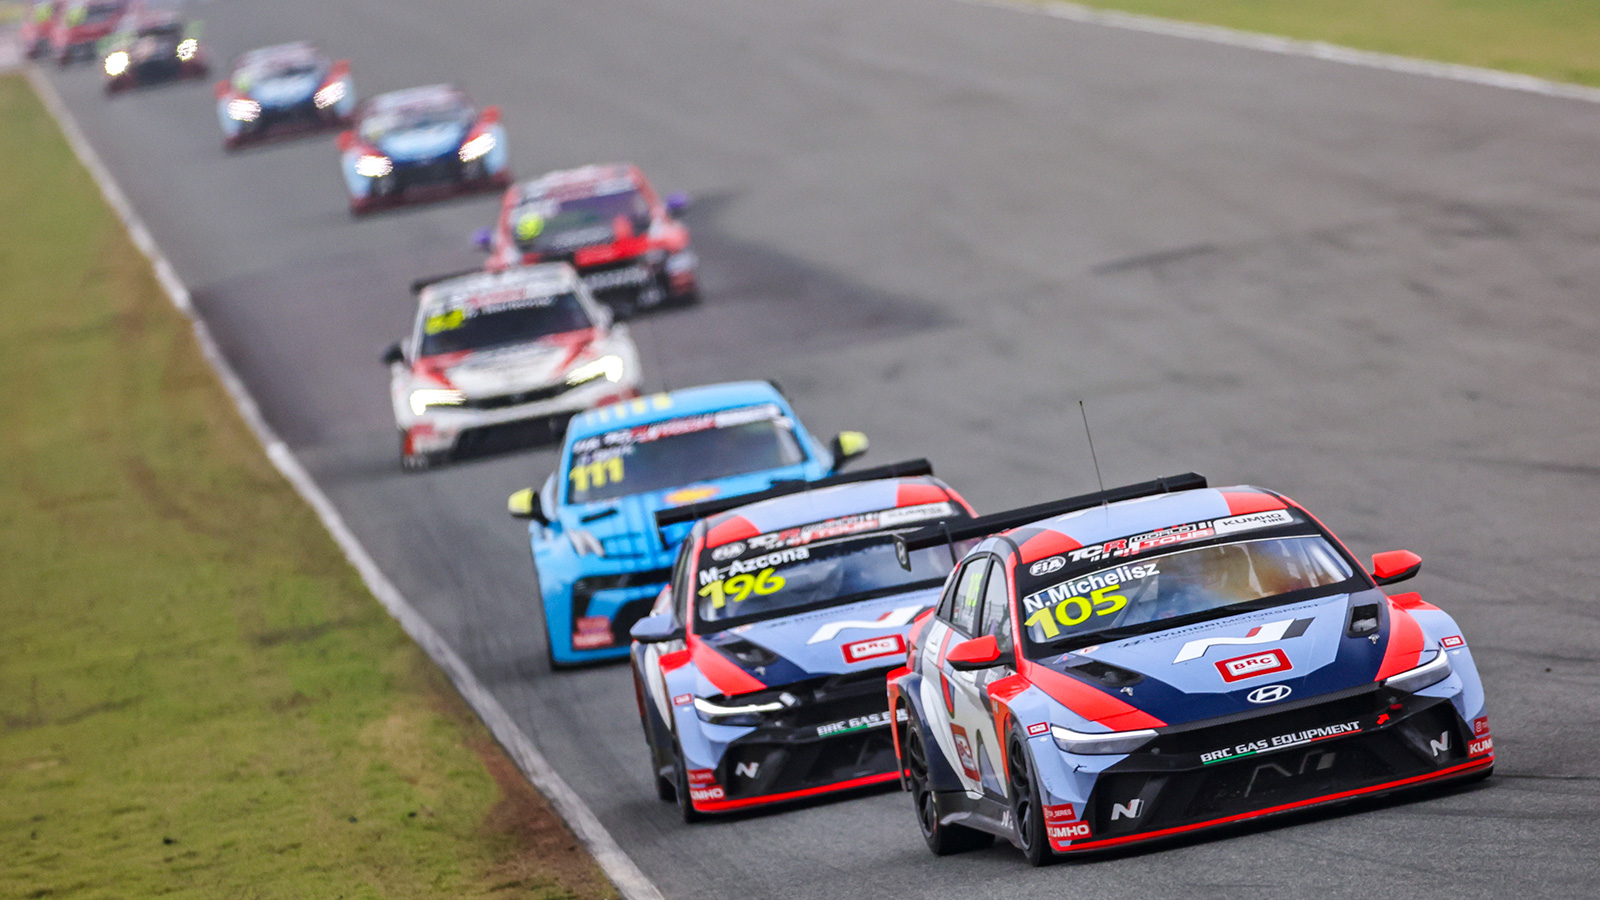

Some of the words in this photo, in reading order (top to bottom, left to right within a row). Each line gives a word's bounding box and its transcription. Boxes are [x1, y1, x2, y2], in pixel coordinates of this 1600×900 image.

[569, 457, 624, 491] 111
[1223, 512, 1282, 526] KUMHO
[1261, 516, 1285, 525] TIRE
[1145, 530, 1210, 547] TOUR
[1068, 539, 1127, 562] TCR
[699, 566, 725, 585] M.
[729, 547, 811, 577] Azcona
[1033, 557, 1064, 573] FIA
[698, 568, 786, 610] 196
[1022, 562, 1160, 613] N.Michelisz
[1024, 584, 1128, 639] 105
[1148, 620, 1220, 641] HYUNDAI
[1227, 603, 1321, 624] MOTORSPORT
[856, 641, 892, 653] BRC
[1233, 657, 1273, 671] BRC
[817, 721, 847, 736] BRC
[849, 713, 880, 728] GAS
[1200, 748, 1232, 762] BRC
[1236, 739, 1268, 754] GAS
[1272, 721, 1360, 746] EQUIPMENT
